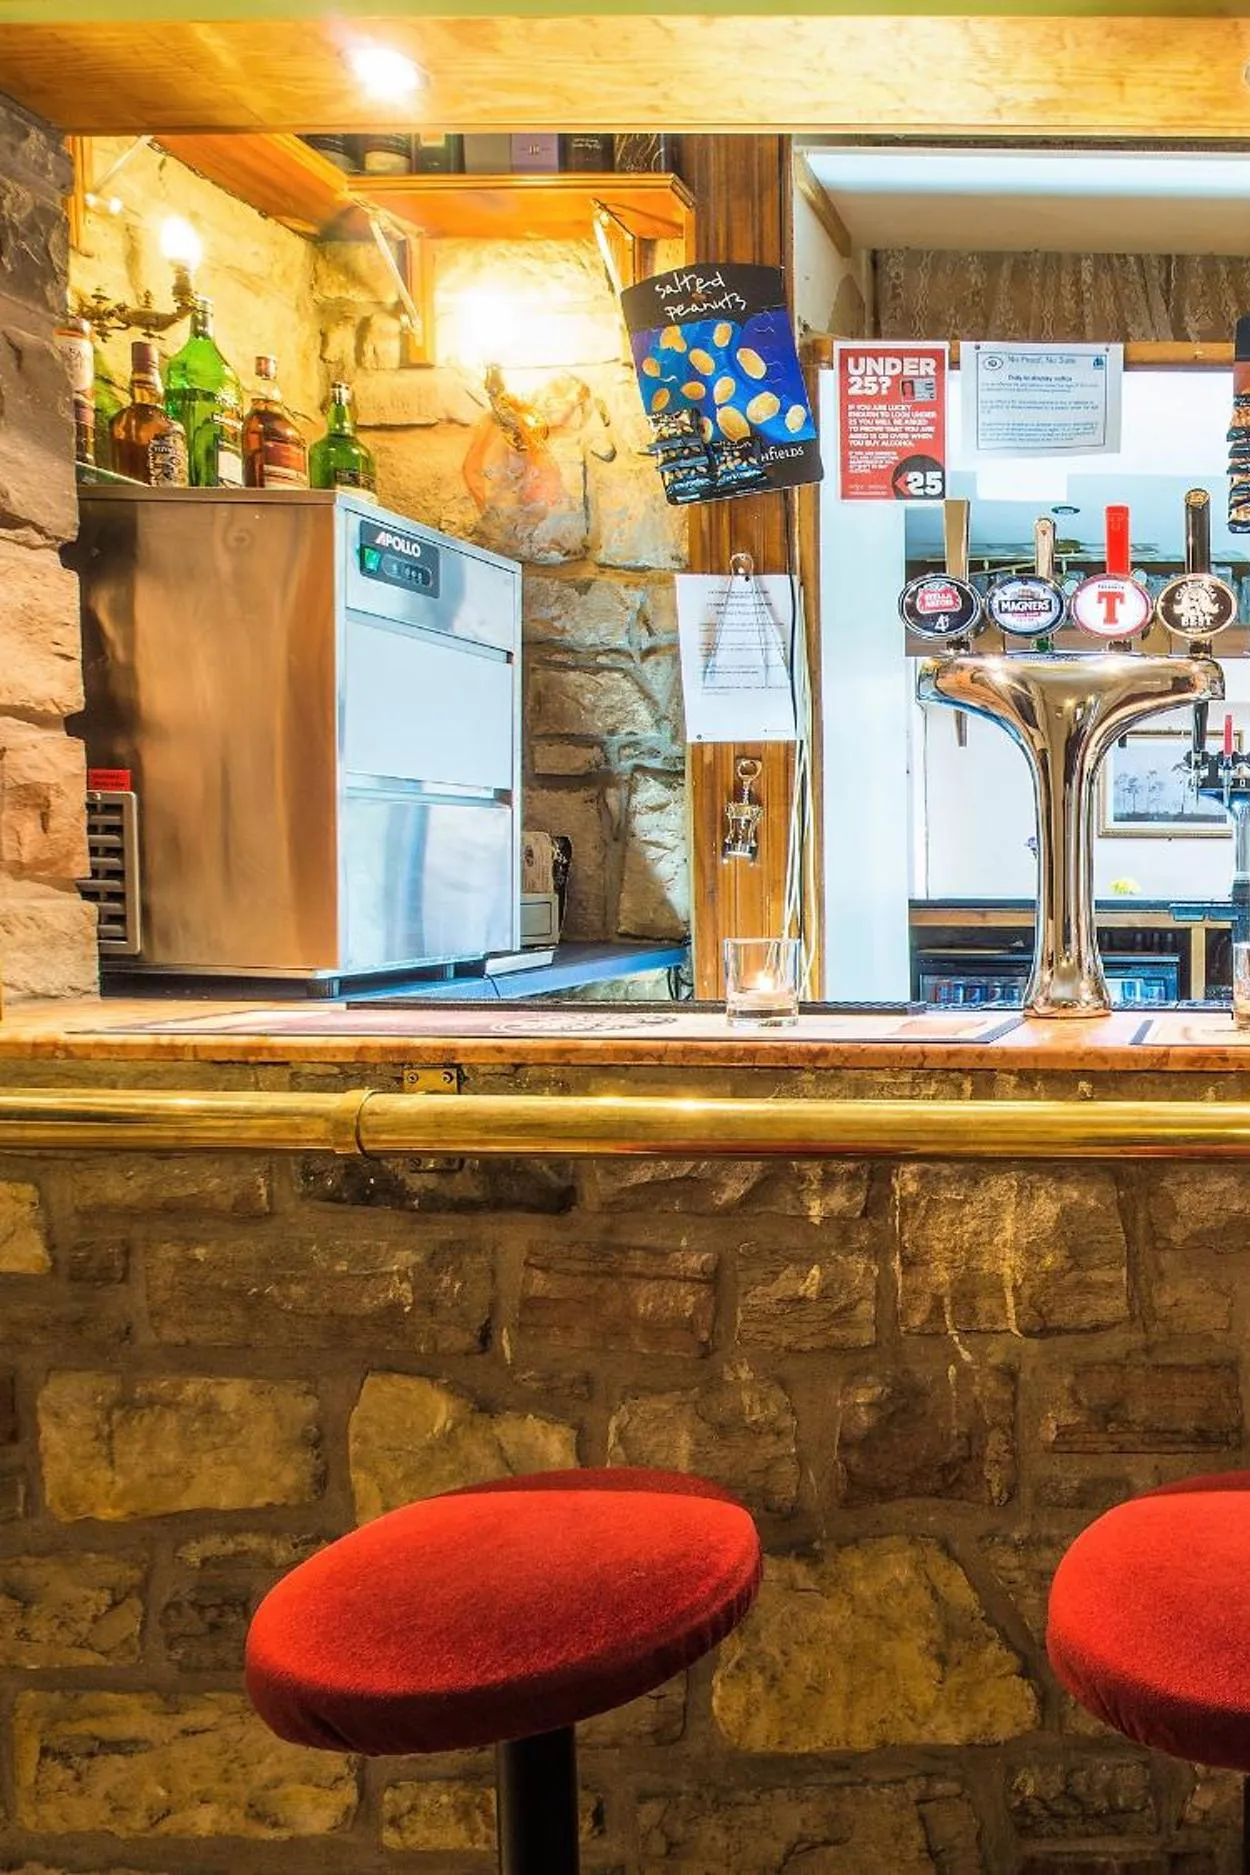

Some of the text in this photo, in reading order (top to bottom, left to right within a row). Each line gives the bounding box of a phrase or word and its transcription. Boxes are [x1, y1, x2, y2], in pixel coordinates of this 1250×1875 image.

[654, 271, 726, 299] salted
[664, 291, 748, 322] peanuts
[847, 356, 937, 376] UNDER
[847, 376, 892, 396] 25?
[907, 471, 943, 496] 25
[375, 531, 422, 558] APOLLO
[1000, 600, 1050, 612] MAGNERS
[1096, 591, 1125, 626] T
